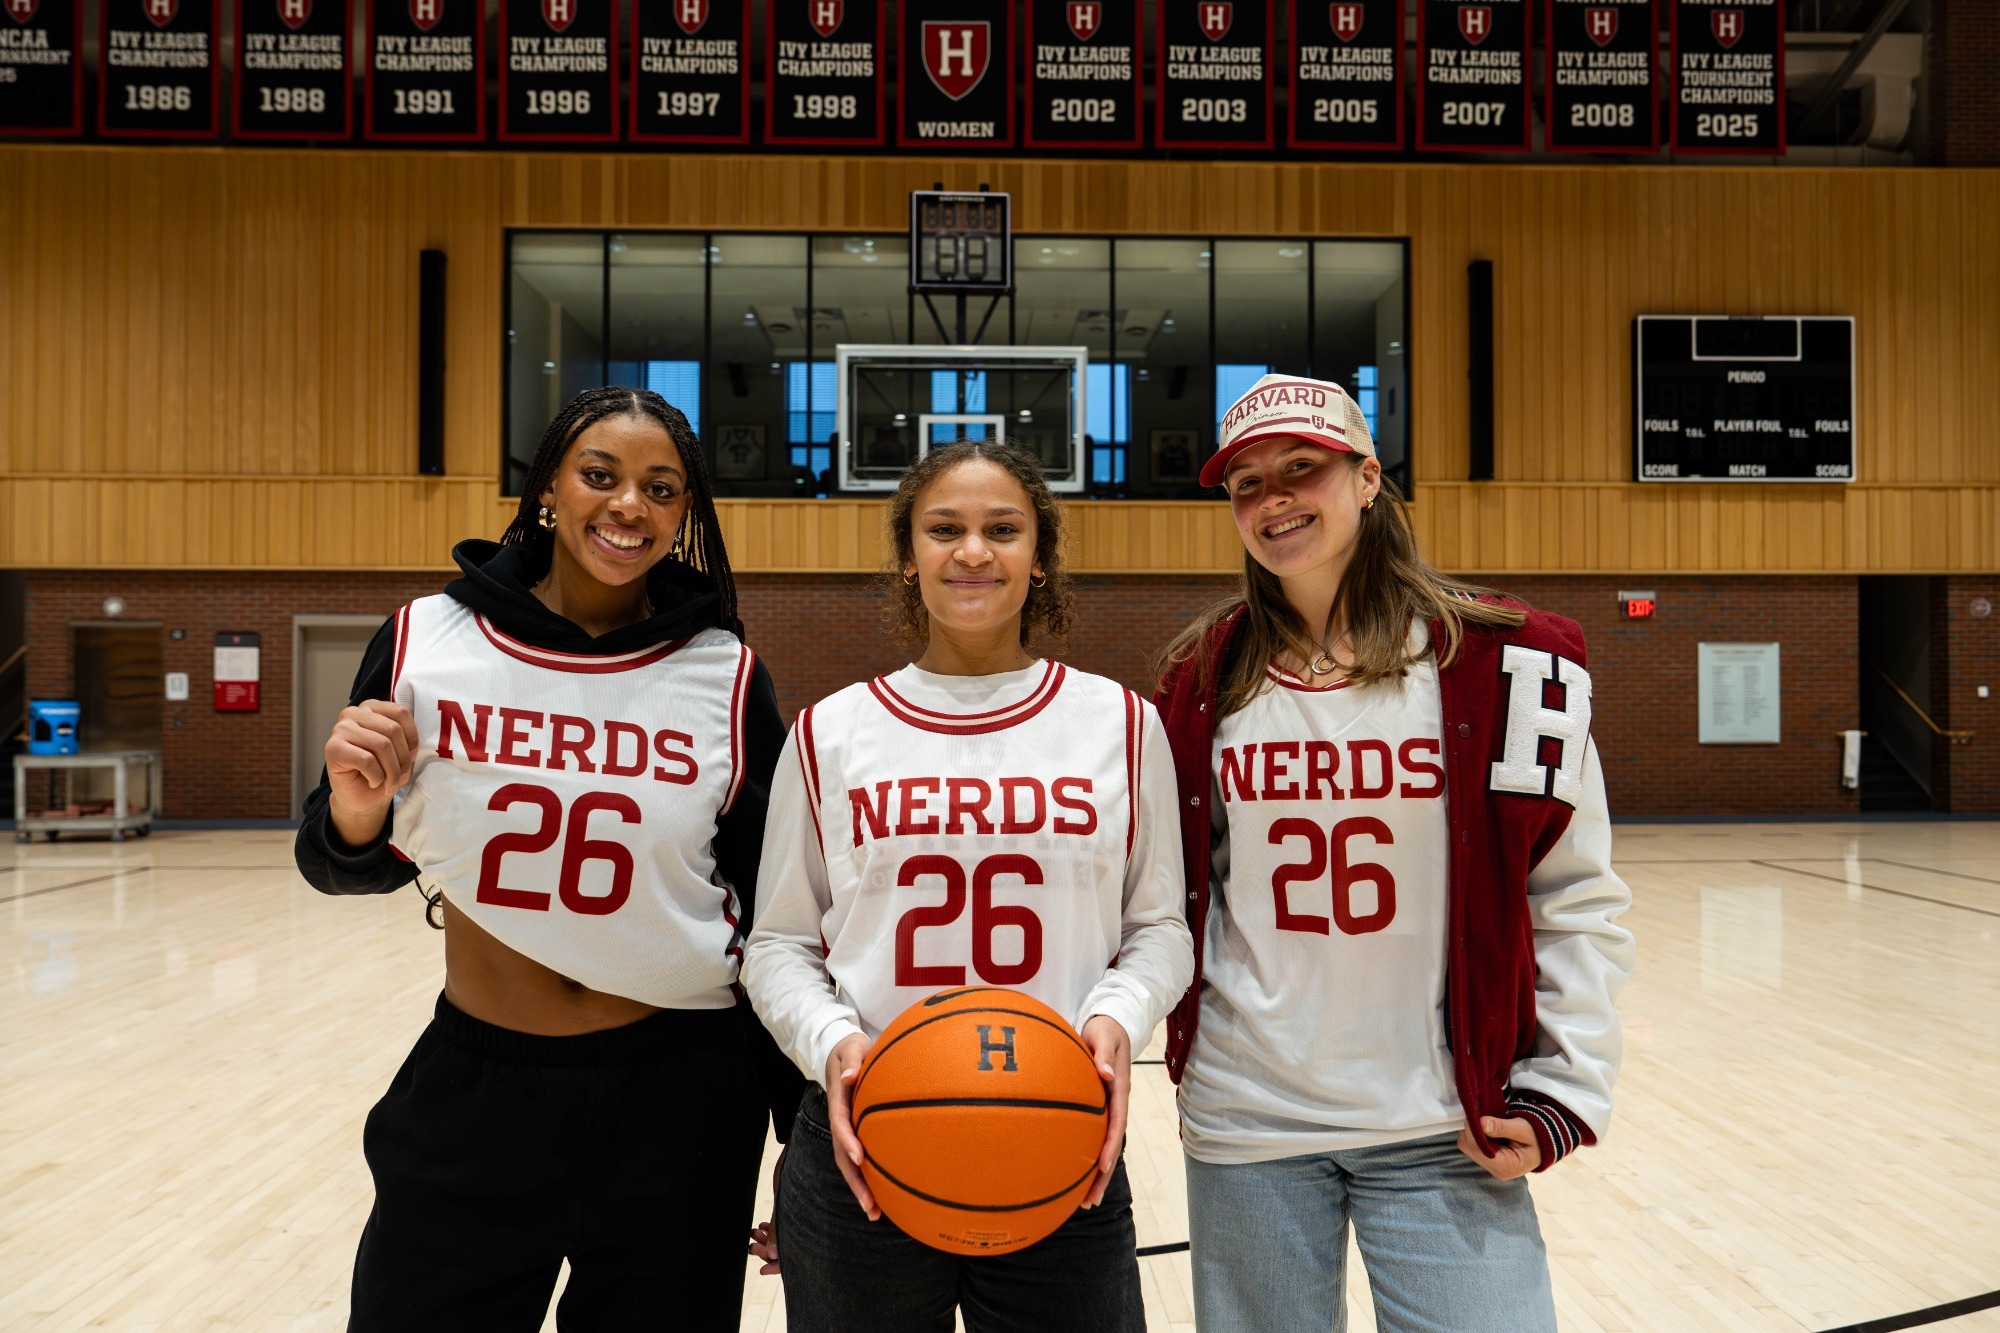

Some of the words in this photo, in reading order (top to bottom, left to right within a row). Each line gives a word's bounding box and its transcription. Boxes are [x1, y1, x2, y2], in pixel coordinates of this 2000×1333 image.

[550, 0, 568, 22] H
[682, 0, 700, 24] H
[817, 1, 836, 27] H
[1075, 5, 1093, 30] H
[1206, 5, 1224, 31] H
[1337, 6, 1356, 31] H
[1466, 9, 1484, 34] H
[1593, 11, 1610, 36] H
[1719, 13, 1736, 38] H
[110, 30, 141, 49] IVY
[145, 31, 208, 50] LEAGUE
[247, 33, 275, 52] IVY
[279, 34, 341, 52] LEAGUE
[377, 35, 407, 53] IVY
[411, 36, 472, 54] LEAGUE
[511, 36, 540, 54] IVY
[544, 37, 606, 54] LEAGUE
[642, 37, 671, 55] IVY
[674, 38, 738, 56] LEAGUE
[109, 49, 208, 68] CHAMPIONS
[778, 41, 808, 59] IVY
[810, 42, 873, 60] LEAGUE
[938, 29, 974, 77] H
[1037, 45, 1066, 62] IVY
[1069, 46, 1130, 63] LEAGUE
[1169, 45, 1197, 62] IVY
[1201, 46, 1261, 63] LEAGUE
[1301, 46, 1329, 63] IVY
[1332, 47, 1393, 64] LEAGUE
[1430, 48, 1457, 66] IVY
[1461, 49, 1521, 67] LEAGUE
[1557, 51, 1584, 68] IVY
[1588, 52, 1648, 68] LEAGUE
[245, 52, 343, 70] CHAMPIONS
[375, 54, 473, 72] CHAMPIONS
[510, 54, 608, 72] CHAMPIONS
[641, 56, 739, 75] CHAMPIONS
[777, 59, 874, 77] CHAMPIONS
[1682, 53, 1710, 69] IVY
[1713, 54, 1773, 70] LEAGUE
[1036, 63, 1132, 81] CHAMPIONS
[1168, 63, 1263, 81] CHAMPIONS
[1299, 64, 1394, 82] CHAMPIONS
[1428, 66, 1522, 85] CHAMPIONS
[1556, 69, 1649, 86] CHAMPIONS
[1682, 71, 1774, 87] TOURNAMENT
[125, 85, 191, 110] 1986
[259, 87, 325, 112] 1988
[393, 90, 455, 114] 1991
[526, 91, 591, 114] 1996
[656, 92, 721, 117] 1997
[1681, 87, 1774, 104] CHAMPIONS
[792, 94, 857, 119] 1998
[1051, 98, 1116, 122] 2002
[1182, 98, 1247, 122] 2003
[1314, 99, 1378, 123] 2005
[1442, 102, 1506, 126] 2007
[1570, 104, 1634, 127] 2008
[918, 121, 995, 138] WOMEN
[1697, 114, 1758, 137] 2025
[1727, 371, 1766, 384] PERIOD
[1224, 387, 1326, 436] HARVARD
[1644, 419, 1679, 432] FOULS
[1713, 420, 1755, 433] PLAYER
[1756, 421, 1783, 433] FOUL
[1815, 420, 1850, 433] FOULS
[1644, 464, 1679, 477] SCORE
[1728, 465, 1767, 477] MATCH
[1815, 465, 1850, 477] SCORE
[1629, 600, 1651, 617] EXIT
[1489, 644, 1593, 810] H
[435, 699, 699, 786] NERDS
[1220, 738, 1446, 803] NERDS
[848, 776, 1098, 849] NERDS
[476, 782, 642, 916] 26
[1267, 816, 1397, 936] 26
[895, 853, 1043, 987] 26
[976, 1025, 1018, 1072] H
